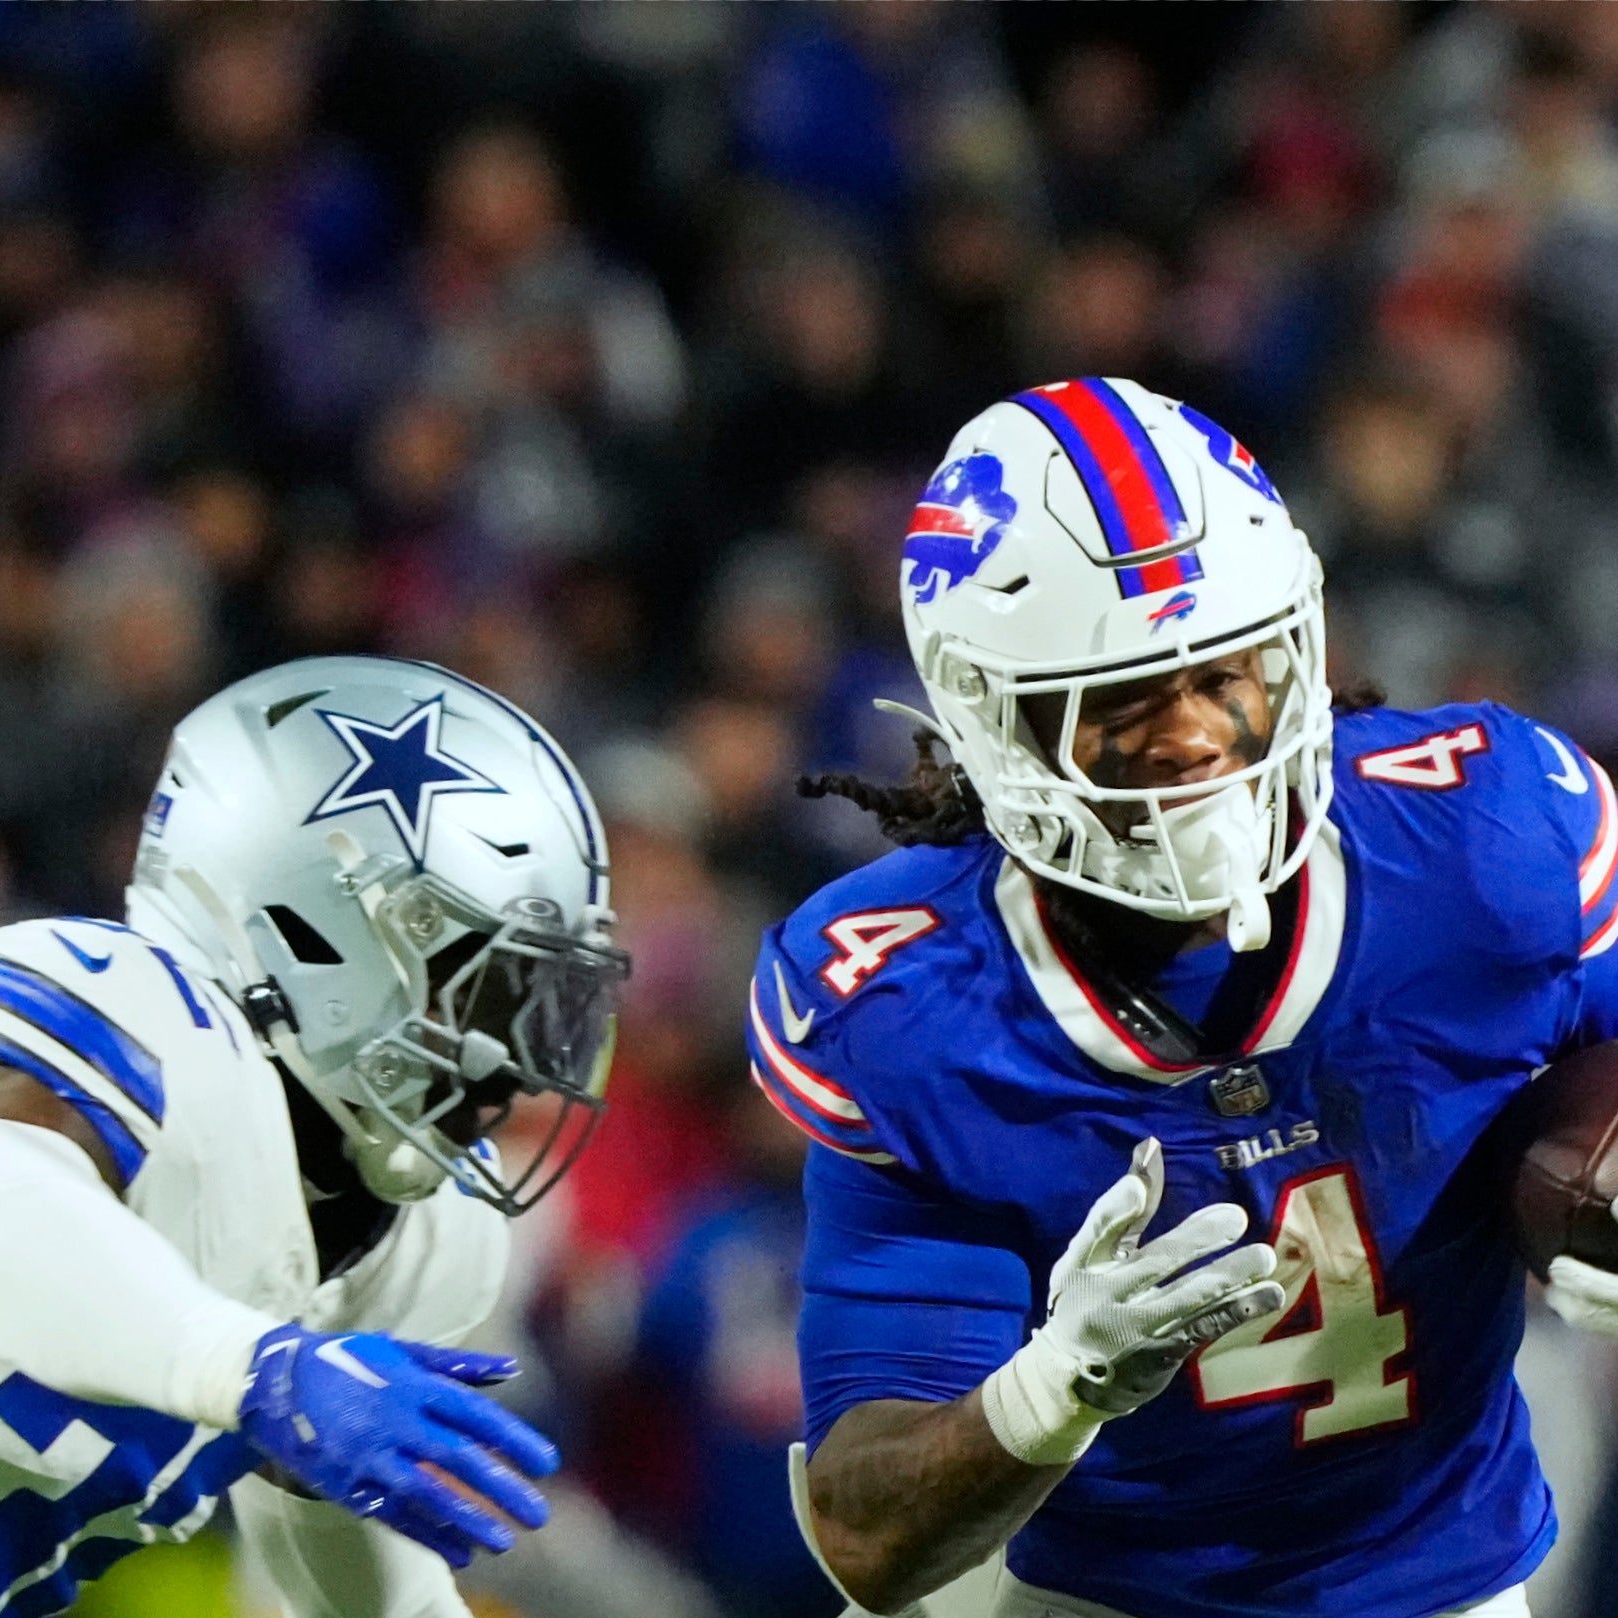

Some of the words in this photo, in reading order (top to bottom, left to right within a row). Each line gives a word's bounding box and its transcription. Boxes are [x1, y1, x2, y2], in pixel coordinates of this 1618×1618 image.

[1354, 722, 1490, 792] 4
[821, 905, 940, 999] 4
[1188, 1163, 1419, 1450] 4
